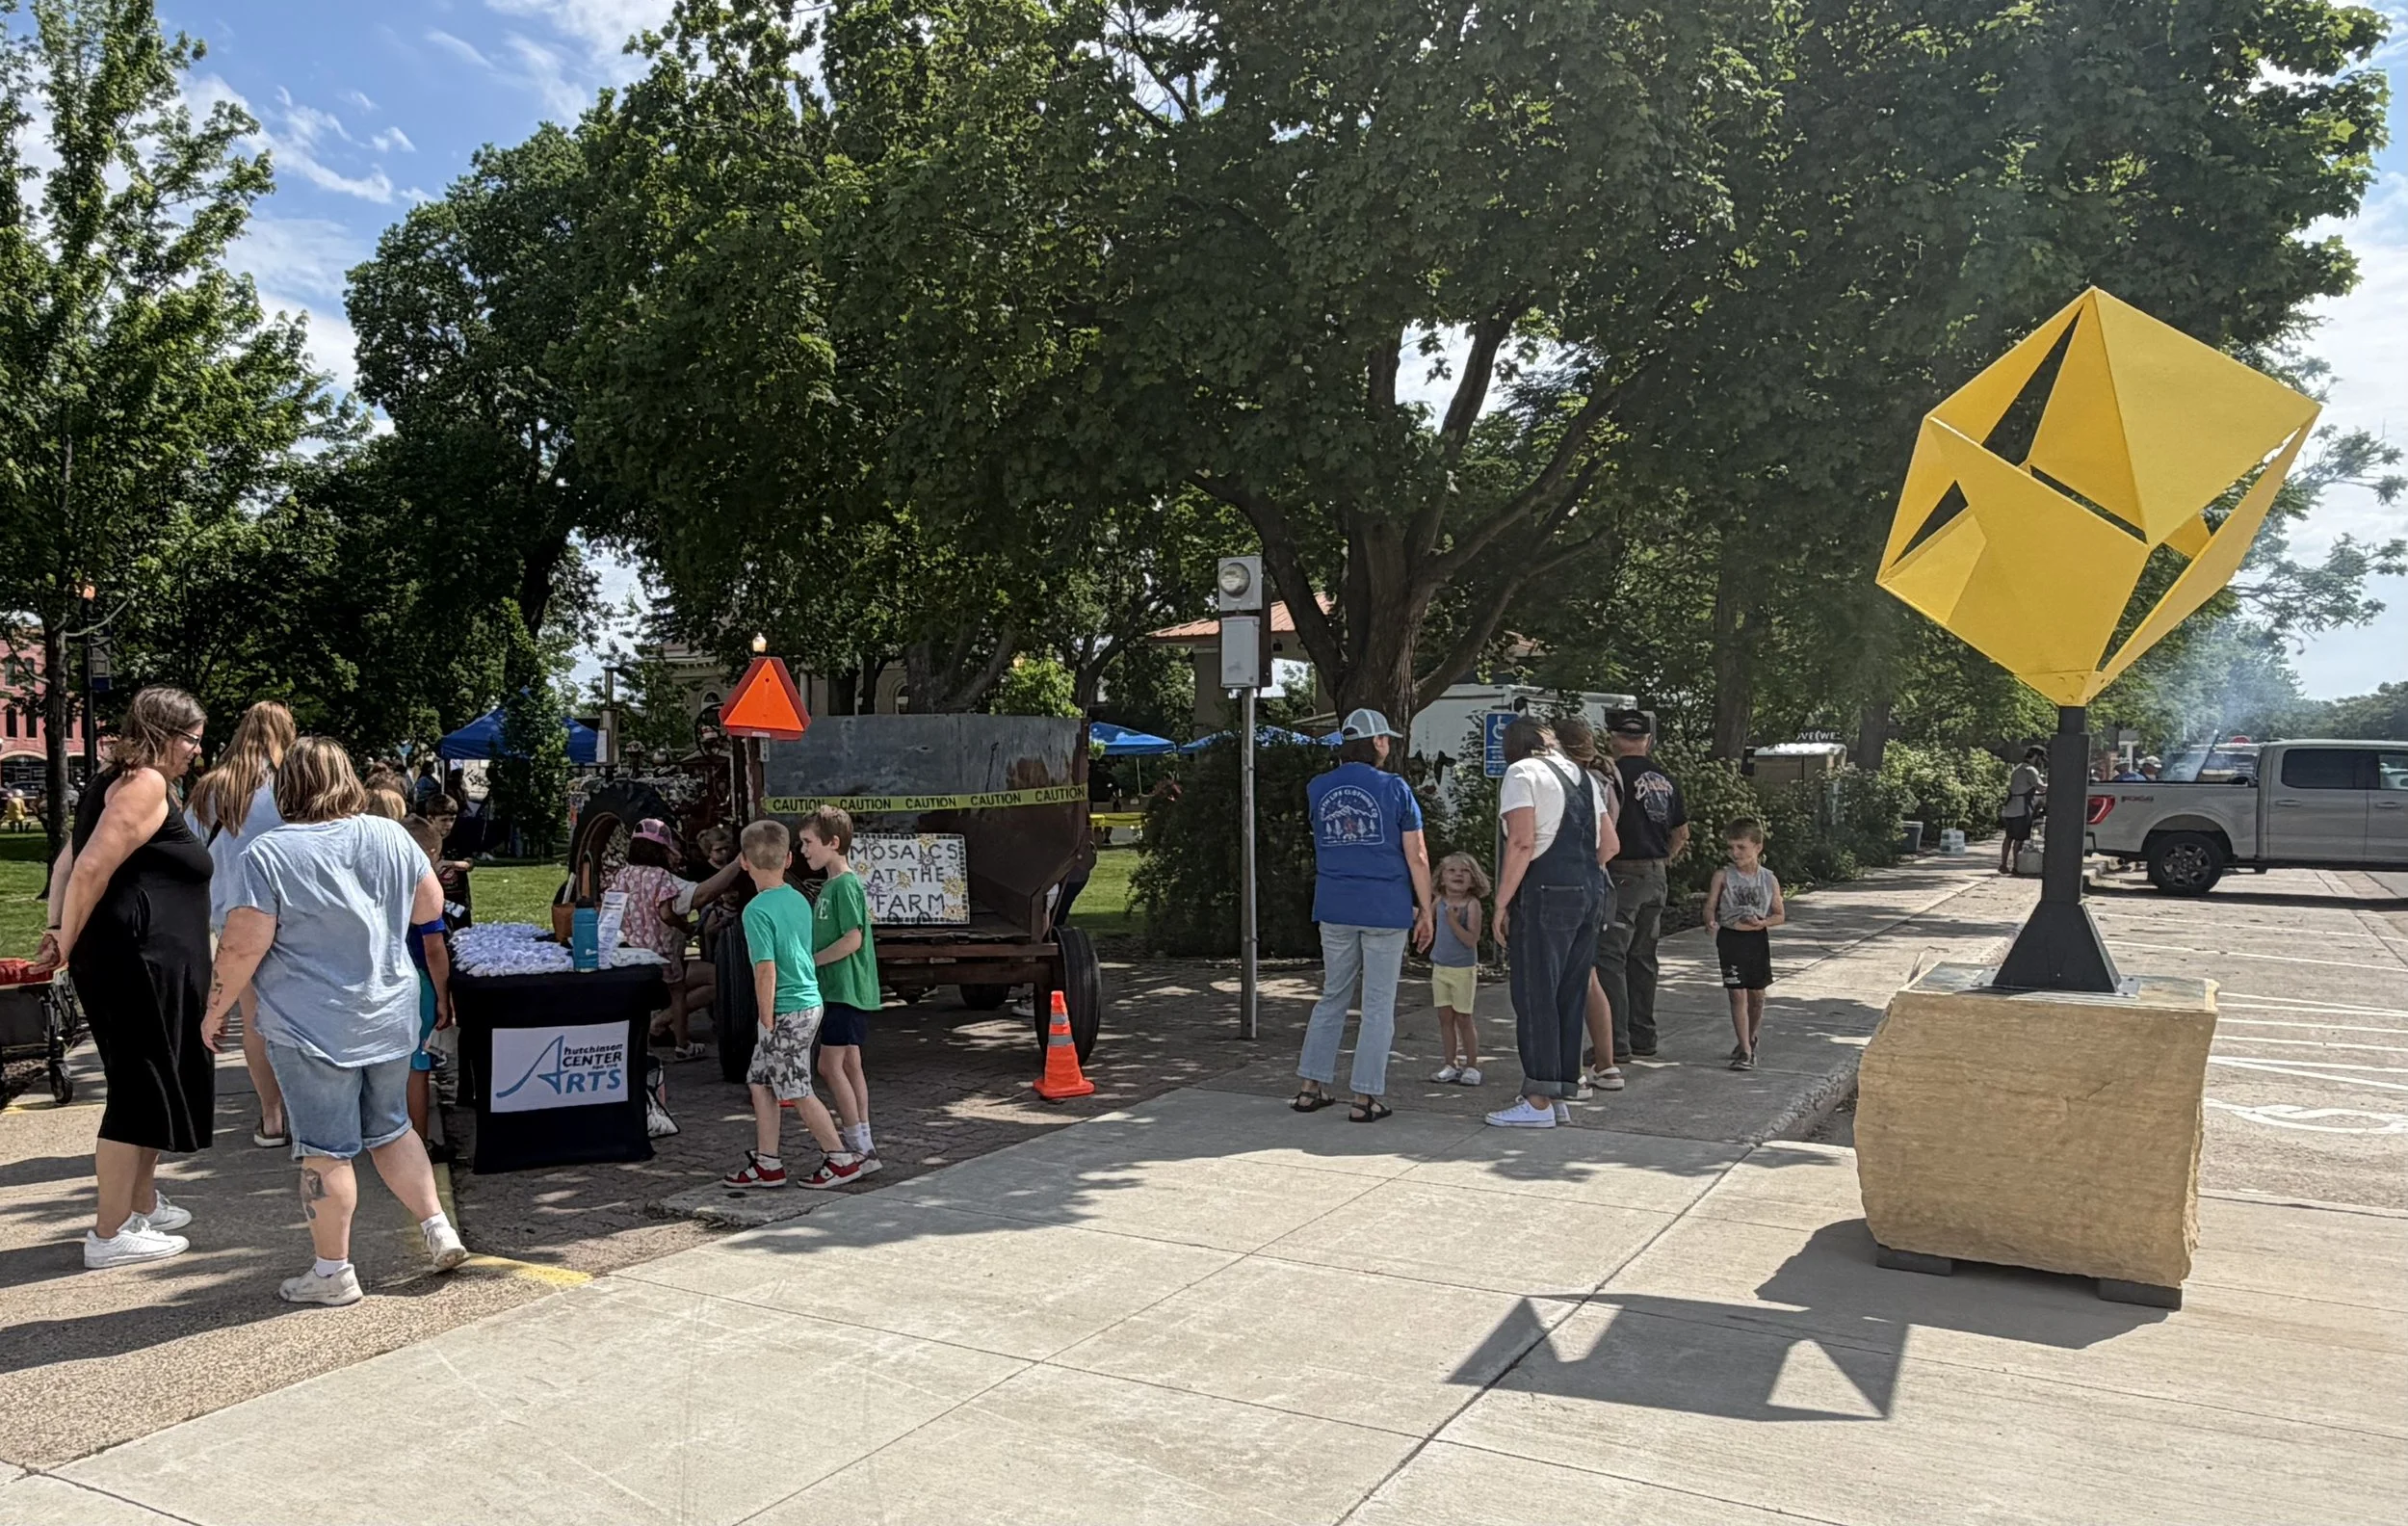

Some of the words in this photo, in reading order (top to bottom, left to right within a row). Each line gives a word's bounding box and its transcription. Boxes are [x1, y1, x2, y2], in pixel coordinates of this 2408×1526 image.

[772, 798, 825, 812] CAUTION
[839, 798, 891, 810] CAUTION
[905, 796, 956, 809] CAUTION
[970, 792, 1022, 806] CAUTION
[1034, 785, 1086, 802] CAUTION
[851, 844, 958, 860] MOSAICS
[871, 868, 896, 882] AT
[907, 867, 945, 882] THE
[876, 893, 945, 913] FARM
[495, 1035, 621, 1098] ARTS
[563, 1051, 622, 1067] CENTER
